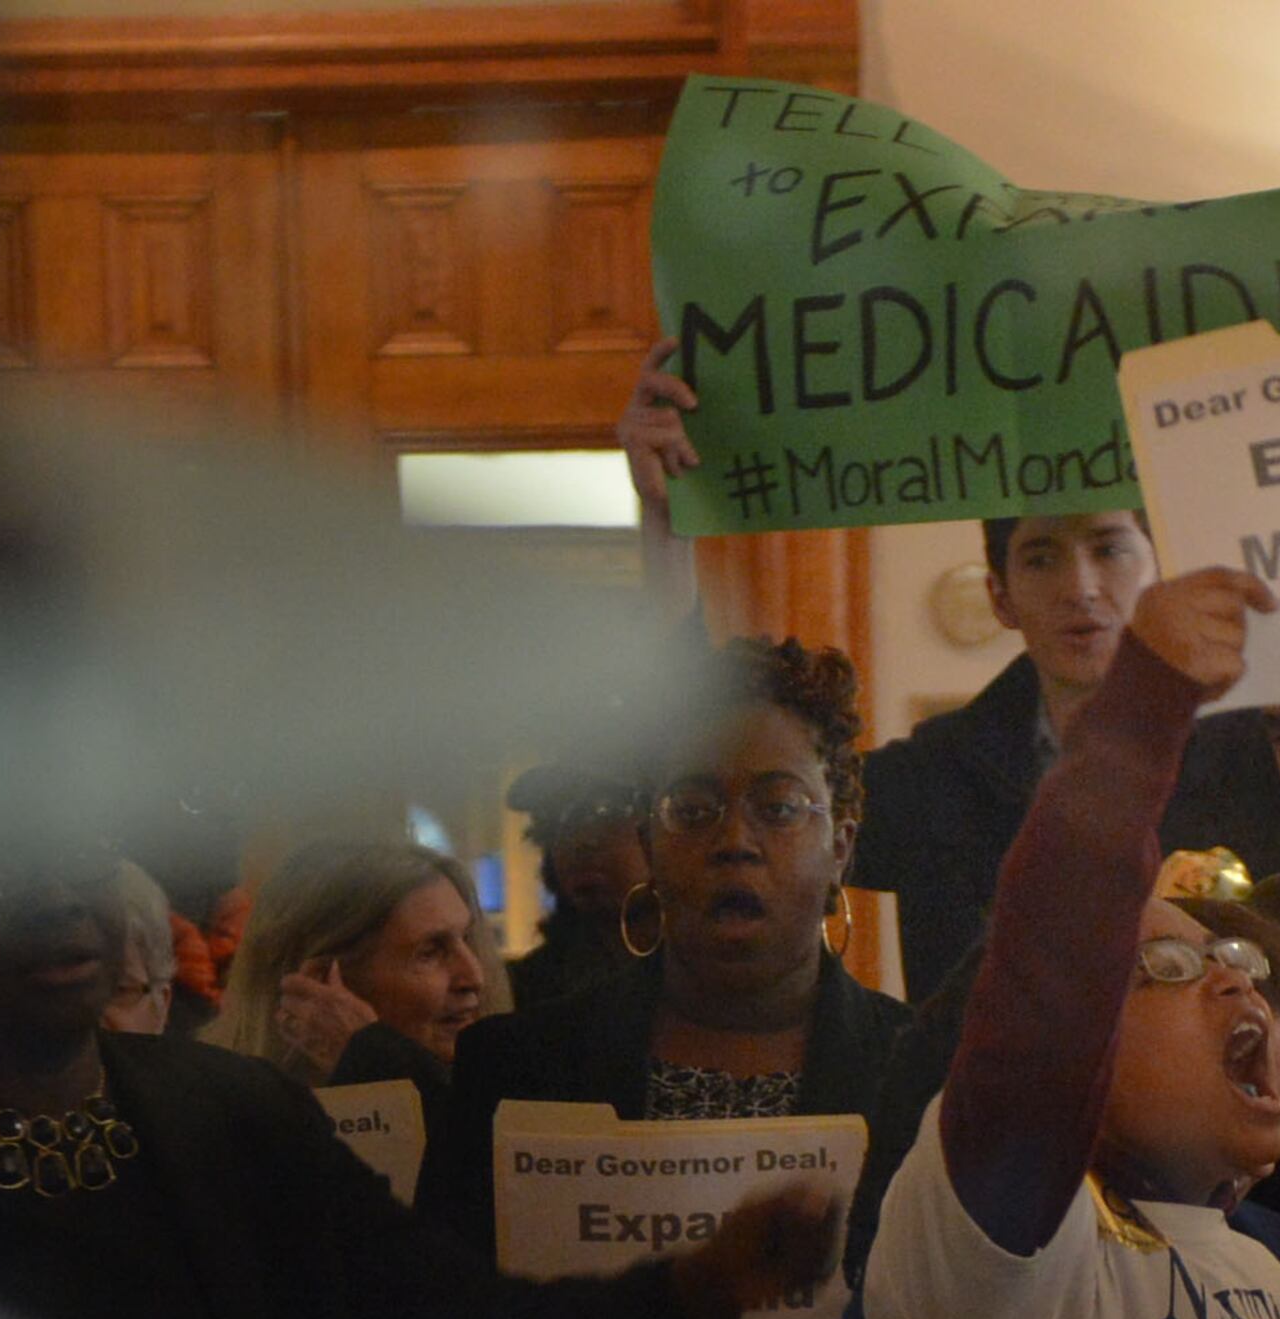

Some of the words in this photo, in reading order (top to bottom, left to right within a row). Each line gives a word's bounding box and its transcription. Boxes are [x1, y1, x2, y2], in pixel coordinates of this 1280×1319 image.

[704, 86, 942, 156] TELL
[730, 162, 804, 198] to
[1154, 388, 1246, 429] Dear
[336, 1109, 391, 1136] eal,
[514, 1152, 585, 1176] Dear
[595, 1153, 744, 1177] Governor
[756, 1147, 837, 1172] Deal,
[578, 1203, 732, 1251] Expa
